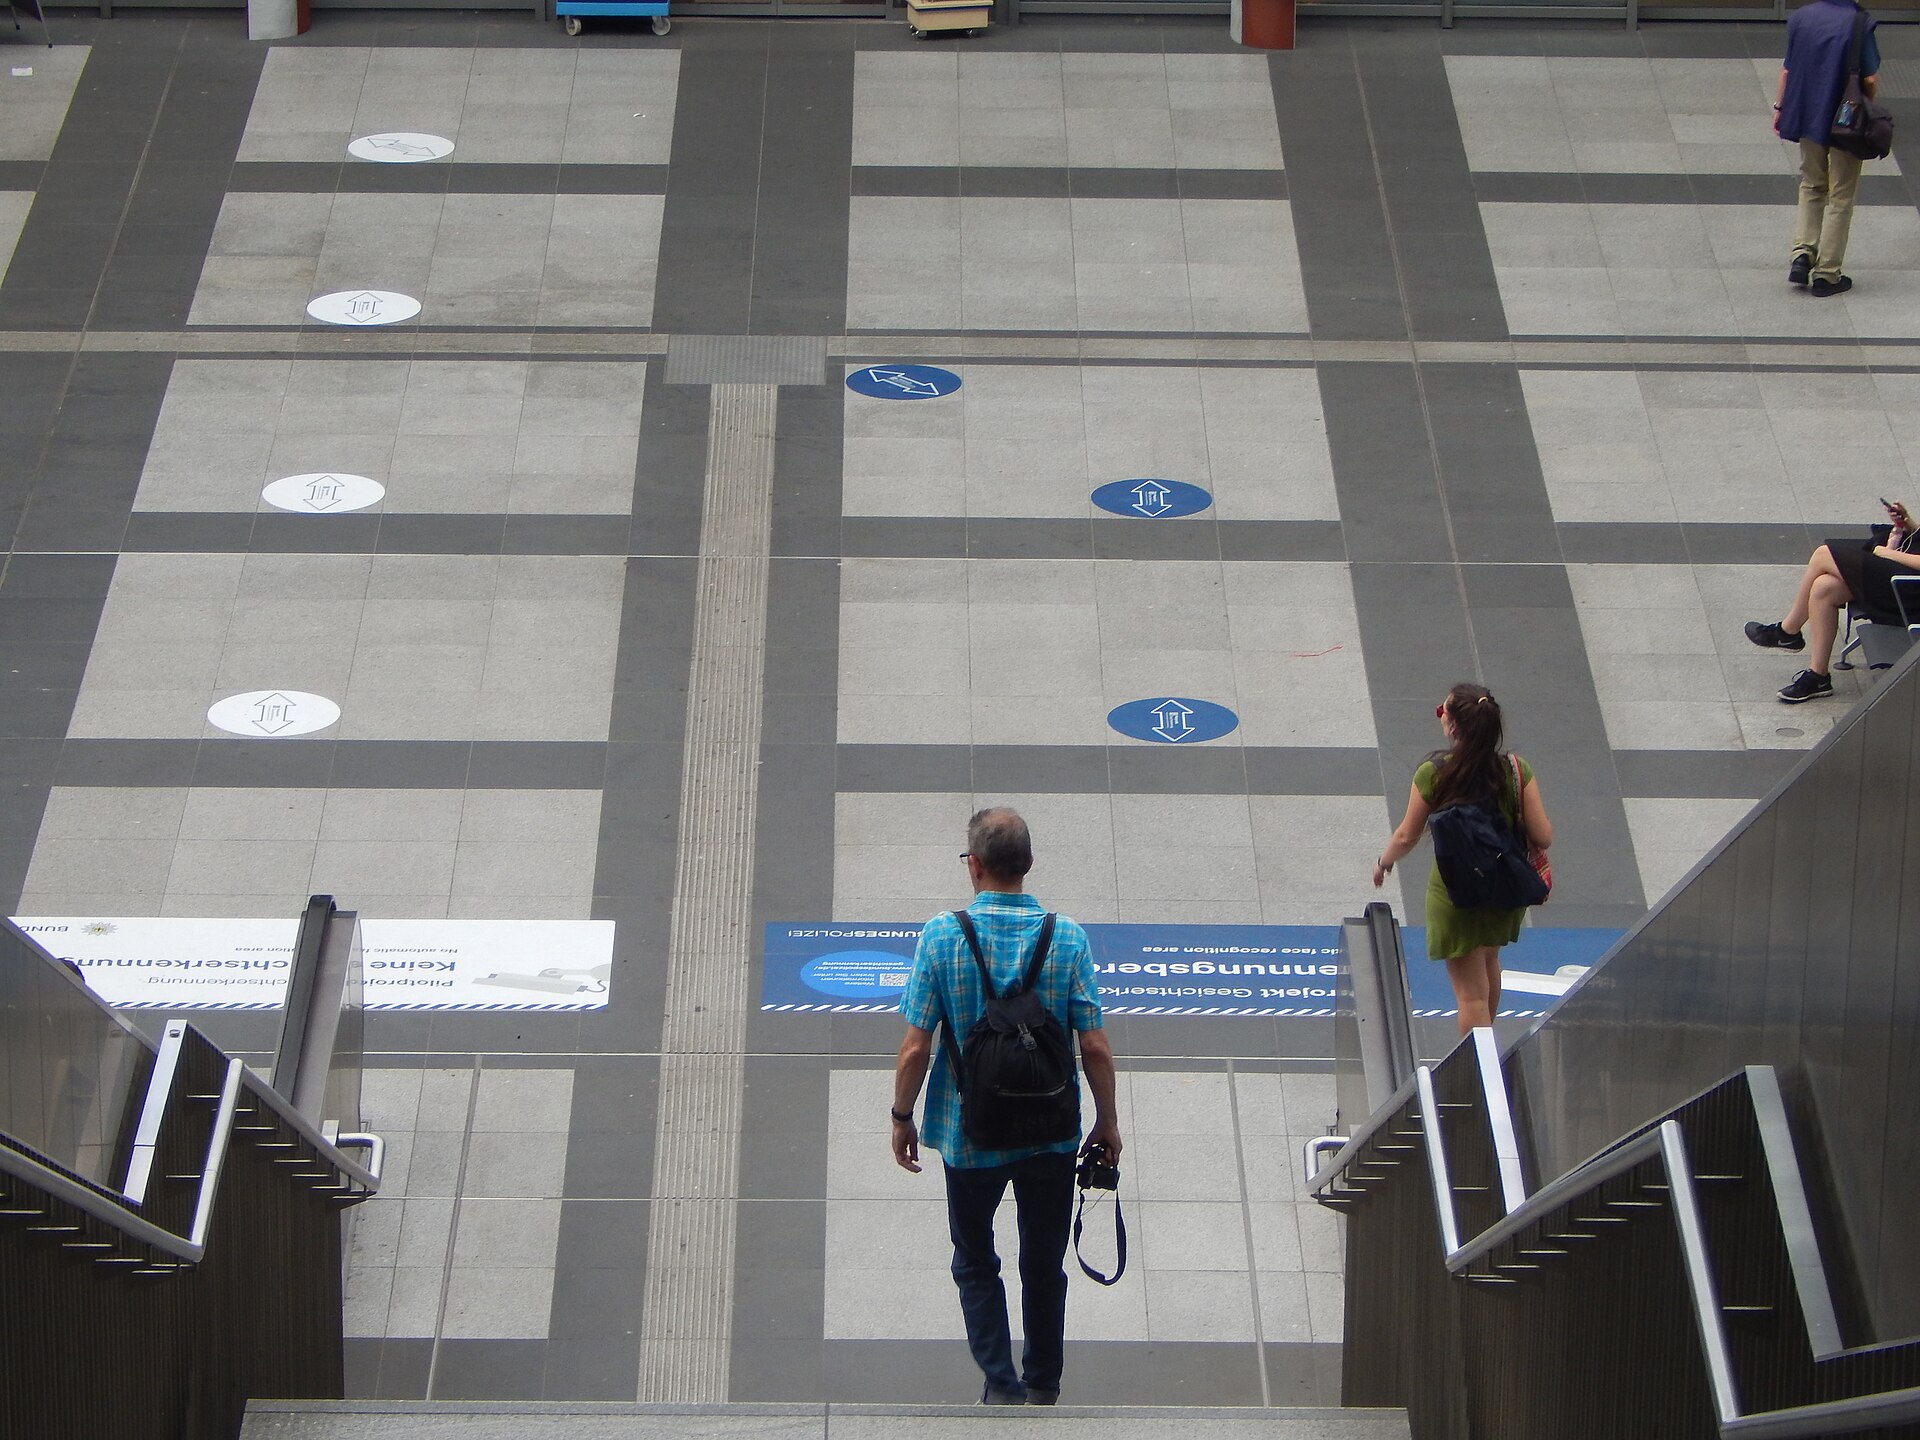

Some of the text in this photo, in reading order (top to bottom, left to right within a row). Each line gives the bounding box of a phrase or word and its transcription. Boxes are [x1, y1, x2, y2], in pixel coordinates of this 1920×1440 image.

[1184, 946, 1277, 955] recognition
[1281, 947, 1317, 955] face
[63, 957, 456, 971] Keine chtserkennun
[1093, 961, 1338, 976] ennungsber
[147, 976, 288, 986] chtserkennung
[1097, 986, 1336, 998] rojekt Gesichtserke
